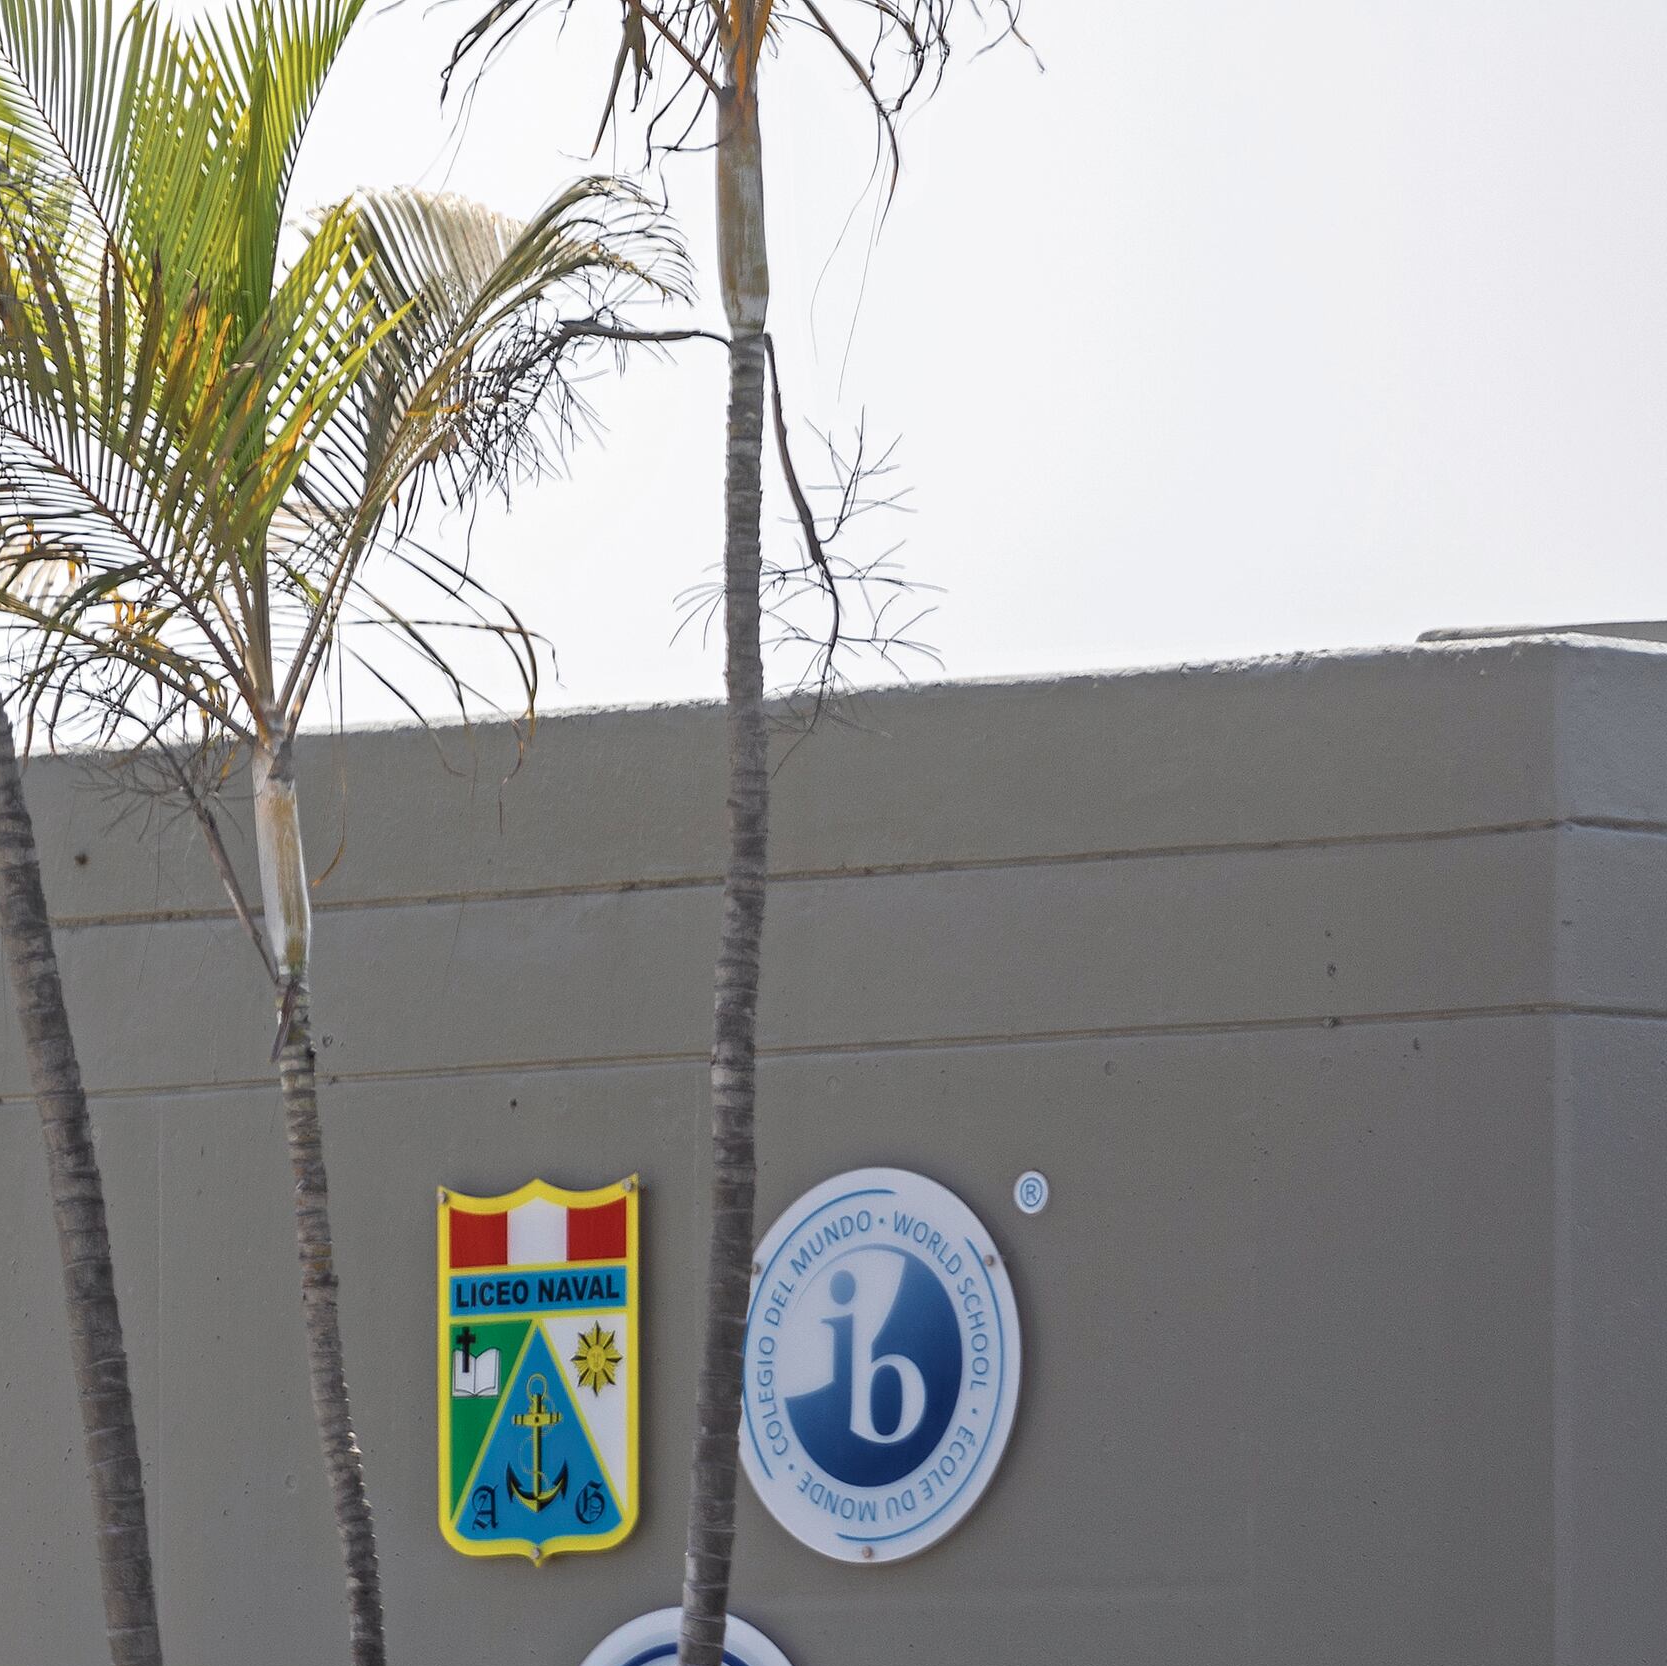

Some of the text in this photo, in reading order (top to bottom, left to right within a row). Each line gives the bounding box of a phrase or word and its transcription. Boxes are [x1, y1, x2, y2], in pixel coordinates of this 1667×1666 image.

[455, 1274, 621, 1309] LICEO NAVAL
[757, 1209, 873, 1457] COLEGIO DEL MUNDO
[819, 1268, 927, 1445] ib
[893, 1209, 990, 1391] WORLD SCHOOL
[796, 1424, 978, 1523] ÉCOLE DU MONDE
